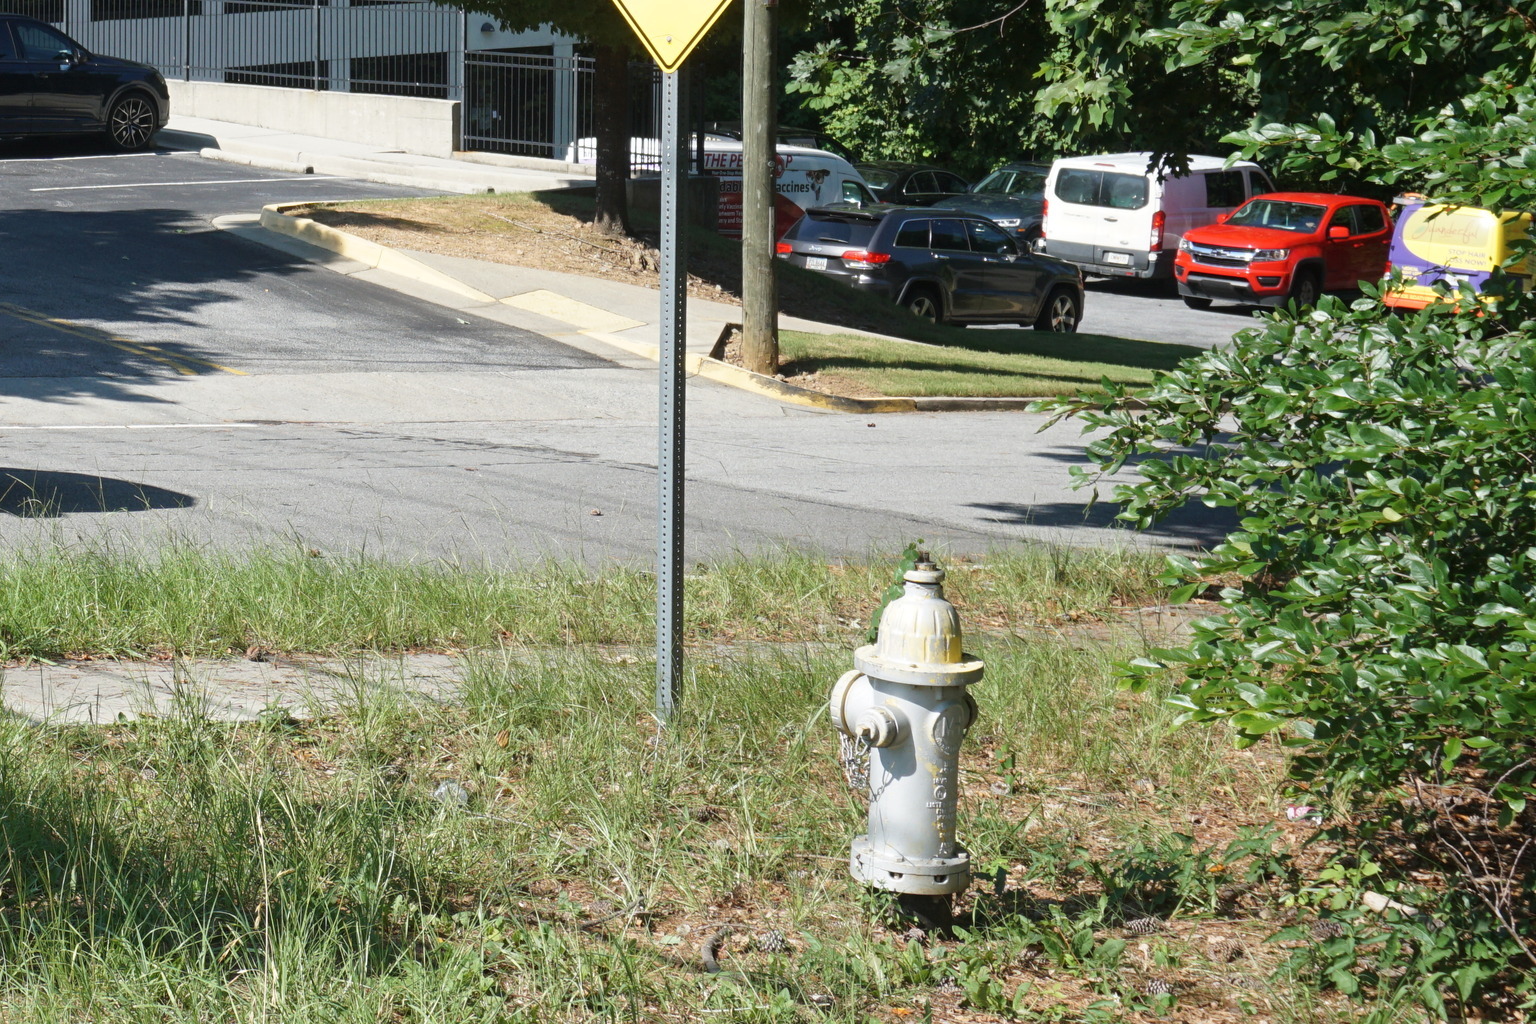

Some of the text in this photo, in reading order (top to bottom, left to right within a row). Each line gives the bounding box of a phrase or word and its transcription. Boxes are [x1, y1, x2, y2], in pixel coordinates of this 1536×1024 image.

[704, 153, 743, 168] THE PE
[776, 180, 810, 193] accines
